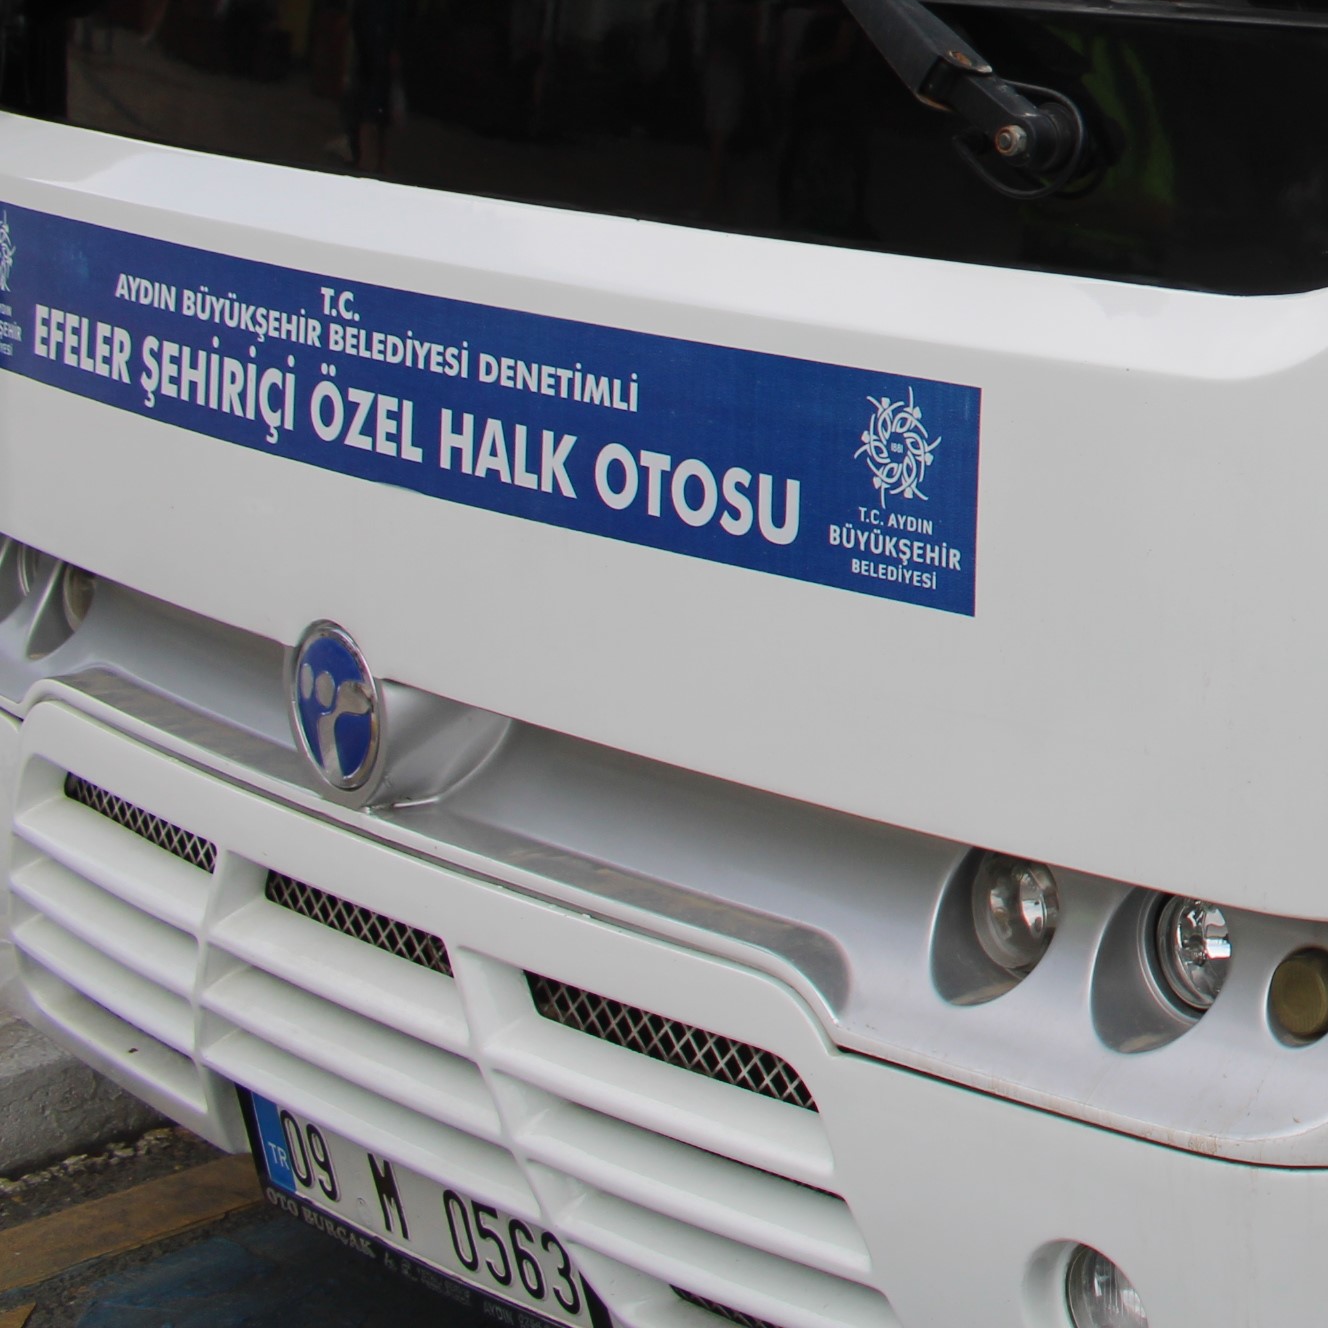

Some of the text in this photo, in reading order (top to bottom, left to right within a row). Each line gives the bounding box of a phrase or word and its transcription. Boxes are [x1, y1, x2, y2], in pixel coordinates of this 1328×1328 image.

[320, 286, 360, 322] T.C.
[114, 273, 639, 413] AYDIN BÜYÜKŞEHİR BELEDİYESİ DENETİMLİ
[33, 303, 801, 546] EFELER ŞEHİRİÇİ ÖZEL HALK OTOSU
[858, 506, 933, 535] T.C. AYDIN
[829, 523, 962, 570] BÜYÜKŞEHİR
[851, 558, 937, 590] BELEDİYESİ
[267, 1141, 290, 1171] TR
[266, 1186, 299, 1217] OTO
[279, 1109, 340, 1202] 09
[367, 1152, 410, 1241] M
[442, 1189, 581, 1315] 0563
